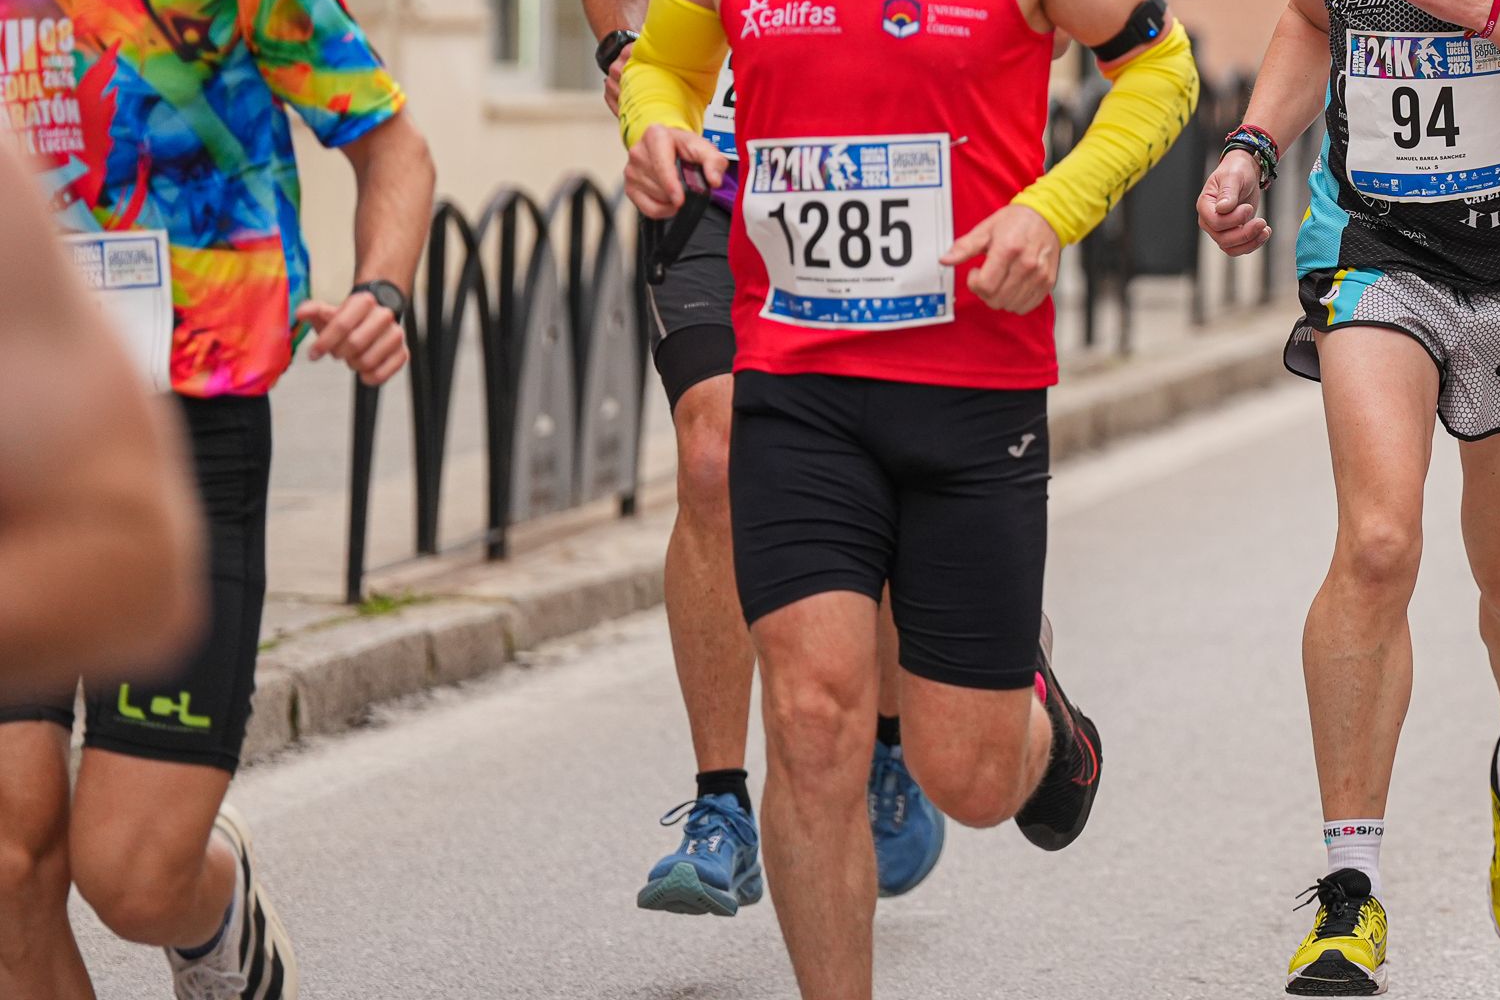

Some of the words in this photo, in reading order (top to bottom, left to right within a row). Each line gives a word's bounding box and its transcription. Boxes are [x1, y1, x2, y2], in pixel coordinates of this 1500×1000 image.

[759, 0, 836, 27] califas
[1366, 37, 1415, 77] 21K
[1446, 47, 1469, 55] LUCENA
[1448, 62, 1471, 75] 2026
[1391, 86, 1460, 149] 94
[770, 146, 826, 191] 21K
[768, 198, 913, 269] 1285
[1323, 825, 1384, 838] PRESSPO
